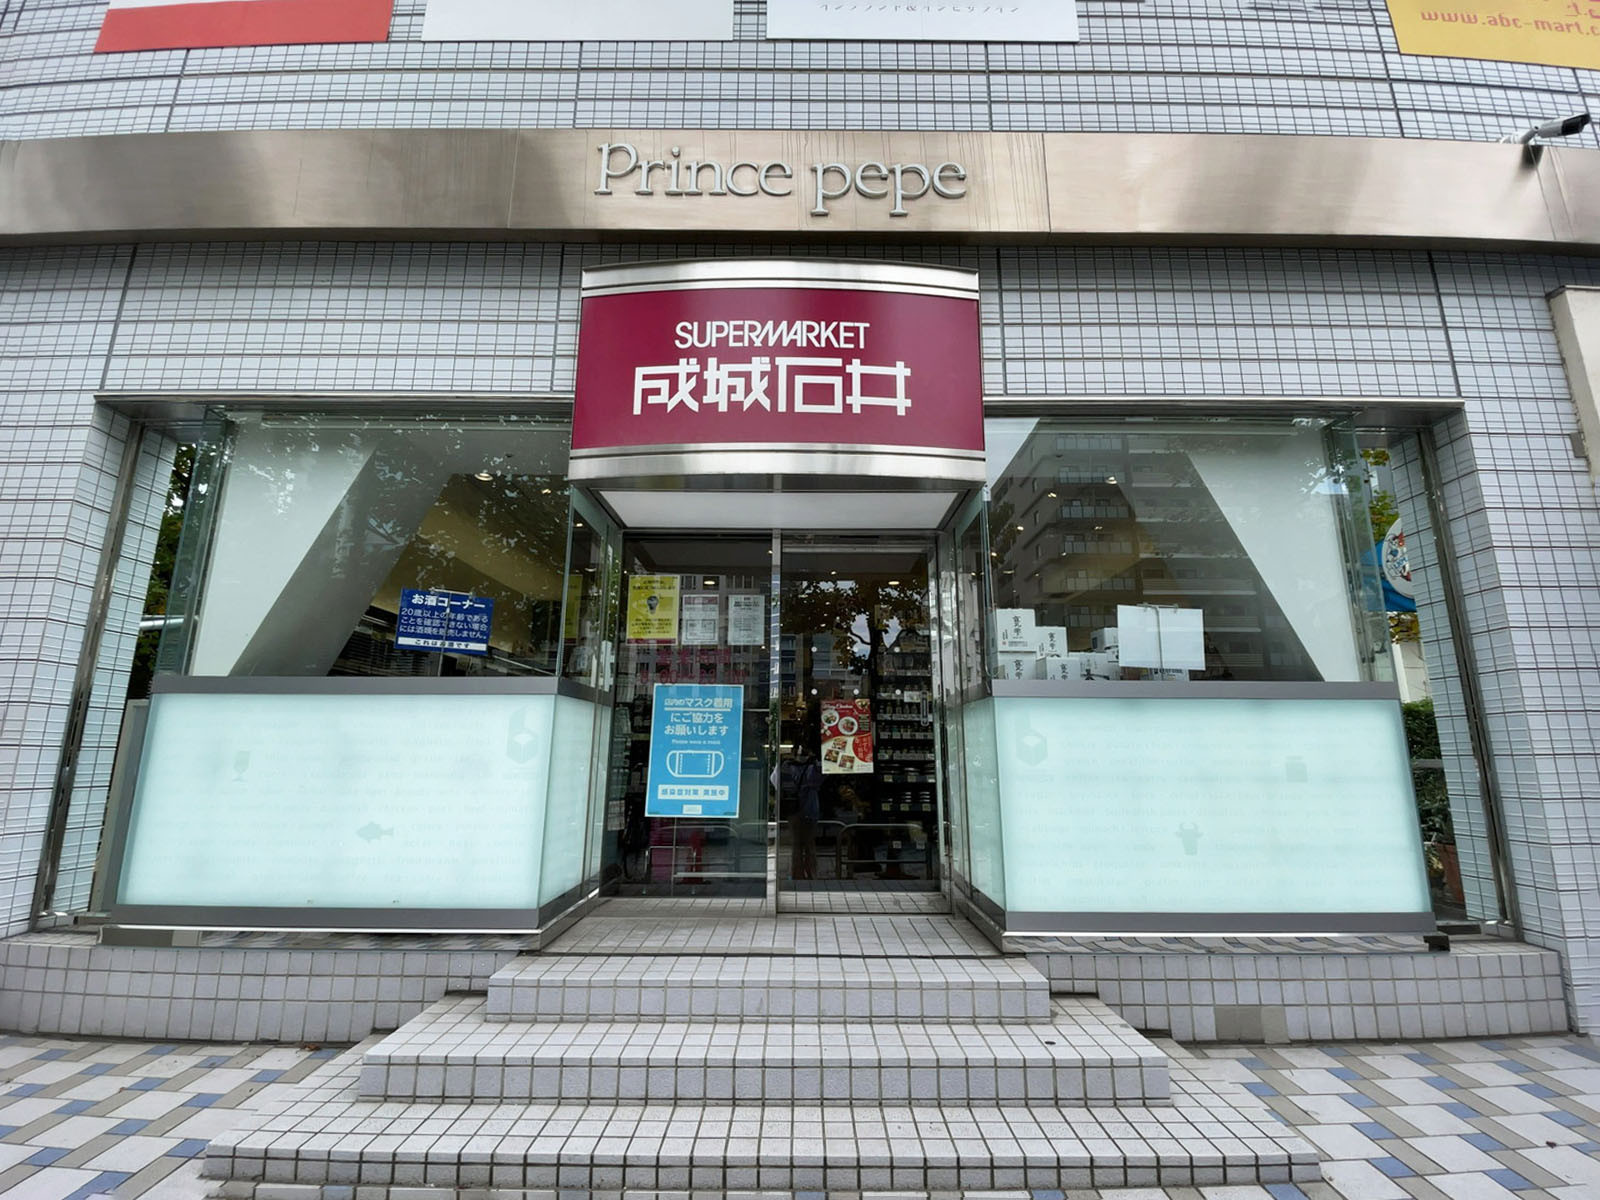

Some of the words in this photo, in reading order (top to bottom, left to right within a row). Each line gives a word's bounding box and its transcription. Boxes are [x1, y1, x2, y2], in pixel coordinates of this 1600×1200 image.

[595, 142, 792, 196] Prince
[810, 161, 967, 216] pepe
[674, 320, 870, 349] SUPERMARKET
[633, 357, 912, 416] 成城石井
[411, 593, 486, 609] お酒コーナー
[671, 712, 724, 724] にご協力を
[664, 724, 729, 736] お願いします
